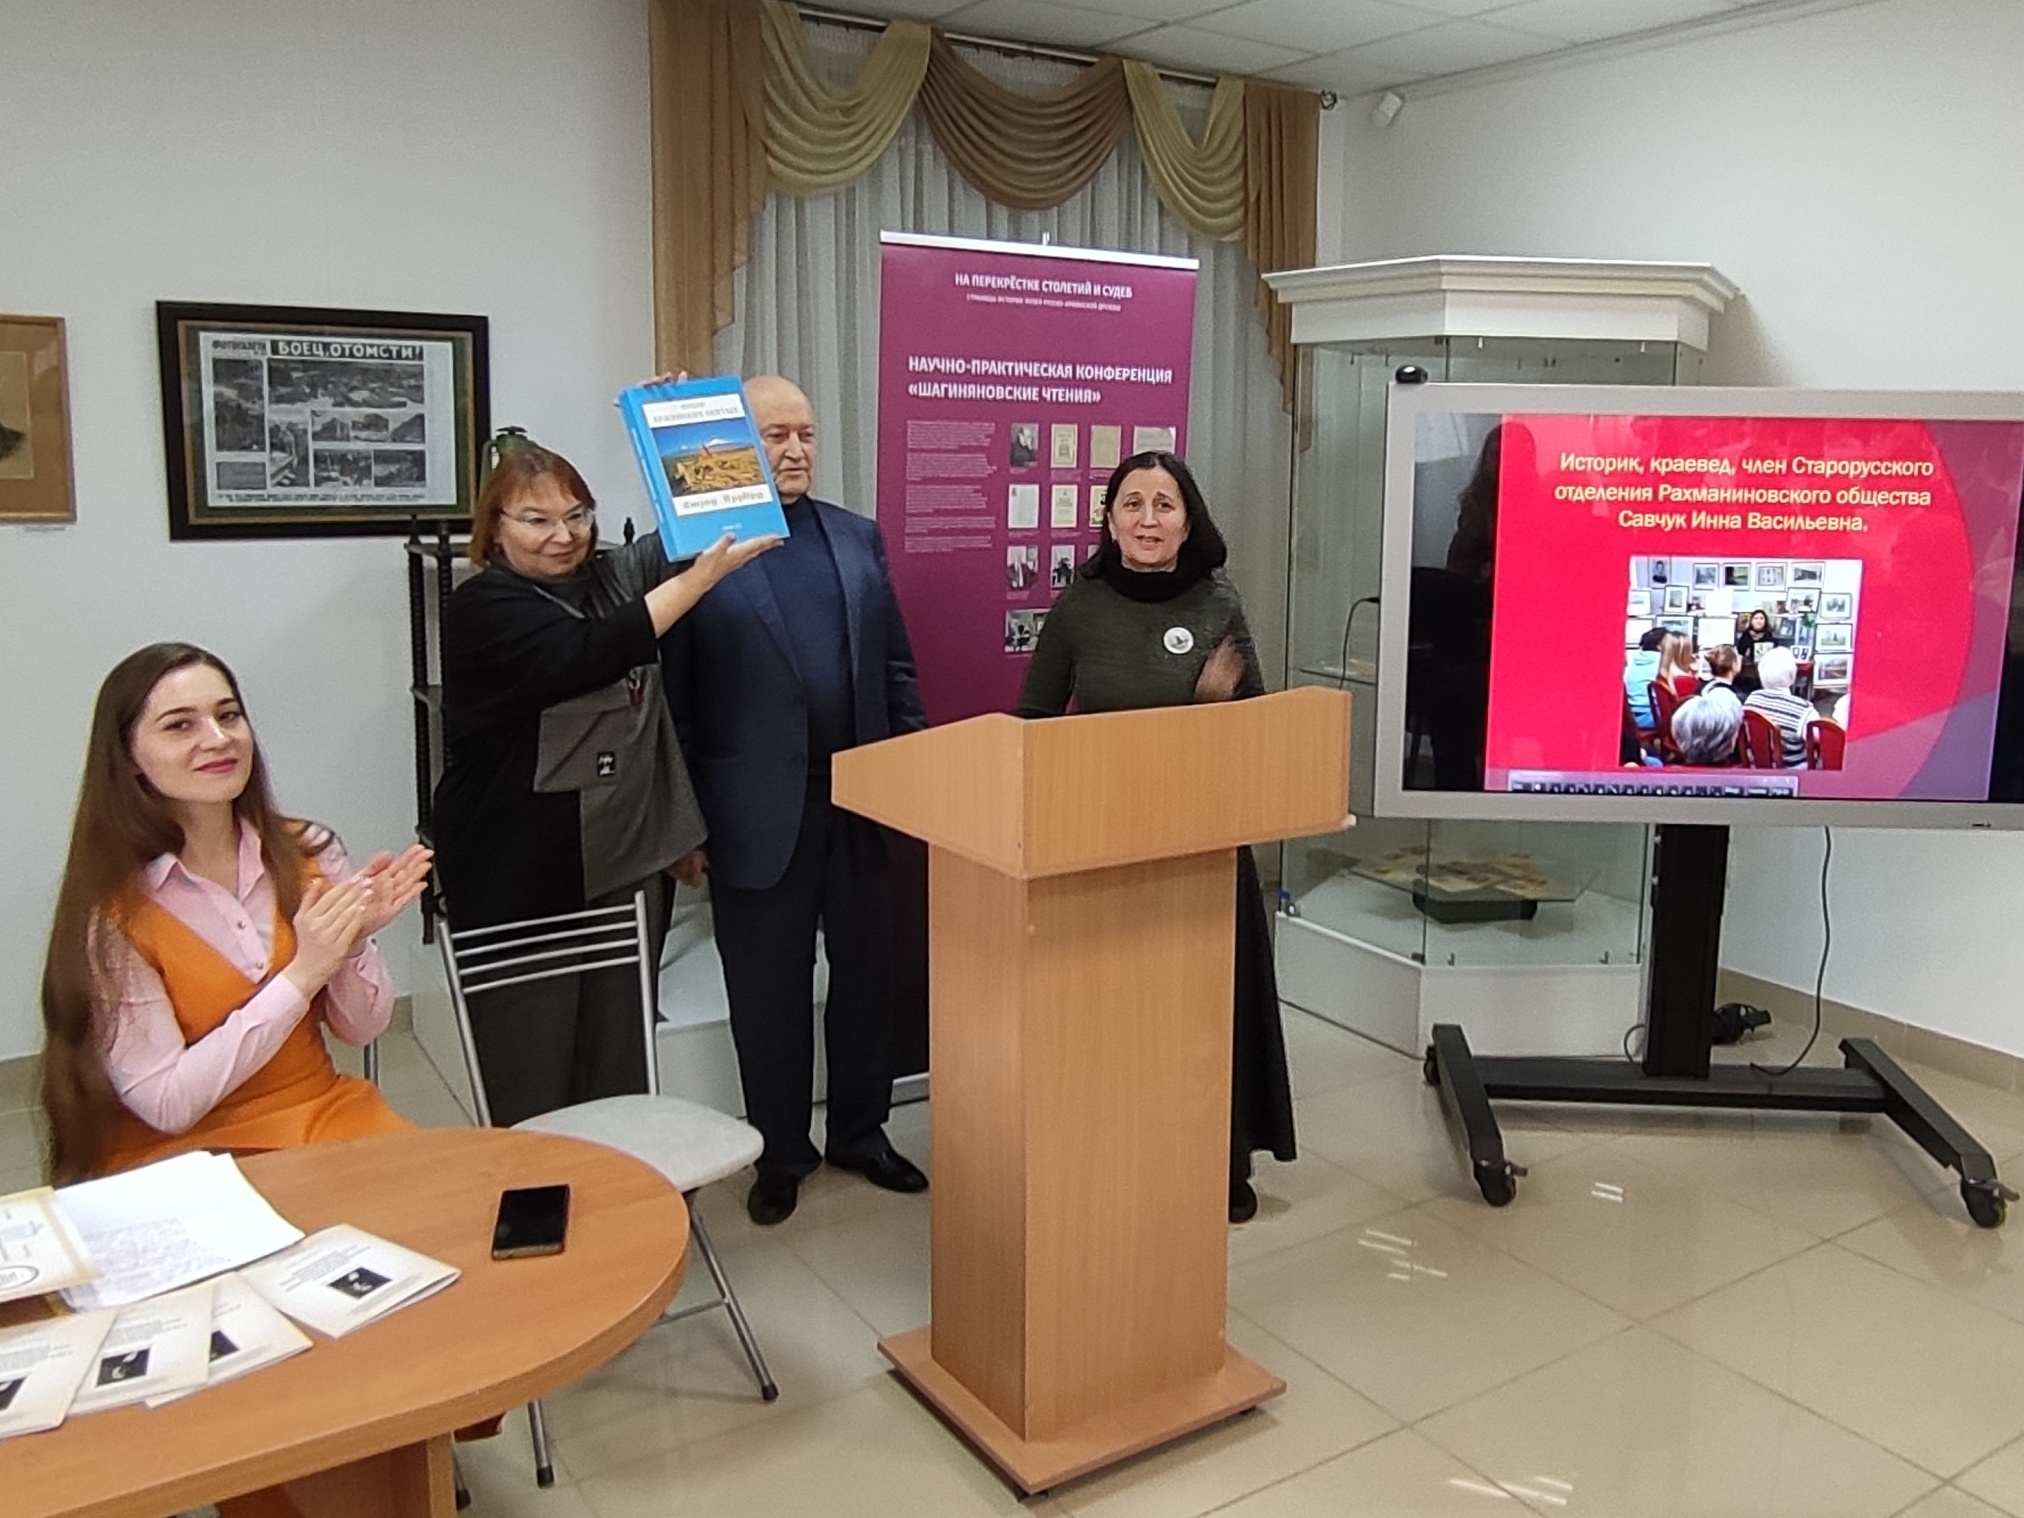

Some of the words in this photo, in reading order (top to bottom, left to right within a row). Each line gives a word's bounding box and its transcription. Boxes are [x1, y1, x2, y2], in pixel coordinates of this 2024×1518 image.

[955, 273, 970, 287] НА
[972, 275, 1040, 292] ПЕРЕКРЁСТКЕ
[1042, 280, 1092, 295] СТОЛЕТИЙ
[1093, 286, 1101, 297] И
[1102, 286, 1133, 300] СУДЕБ
[908, 356, 1073, 380] НАУЧНО-ПРАКТИЧЕСКАЯ
[1076, 364, 1173, 385] КОНФЕРЕНЦИЯ
[908, 382, 1040, 402] «ШАГИНЯНОВСКИЕ
[1042, 388, 1101, 404] ЧТЕНИЯ»
[1560, 453, 1645, 475] Историк,
[1650, 457, 1736, 477] краевед,
[1742, 460, 1786, 475] член
[1792, 457, 1934, 480] Старорусского
[1555, 486, 1653, 503] отделения
[1658, 485, 1831, 506] Рахманиновского
[1836, 489, 1931, 507] общества
[1618, 510, 1687, 532] Савчук
[1692, 511, 1742, 529] Инна
